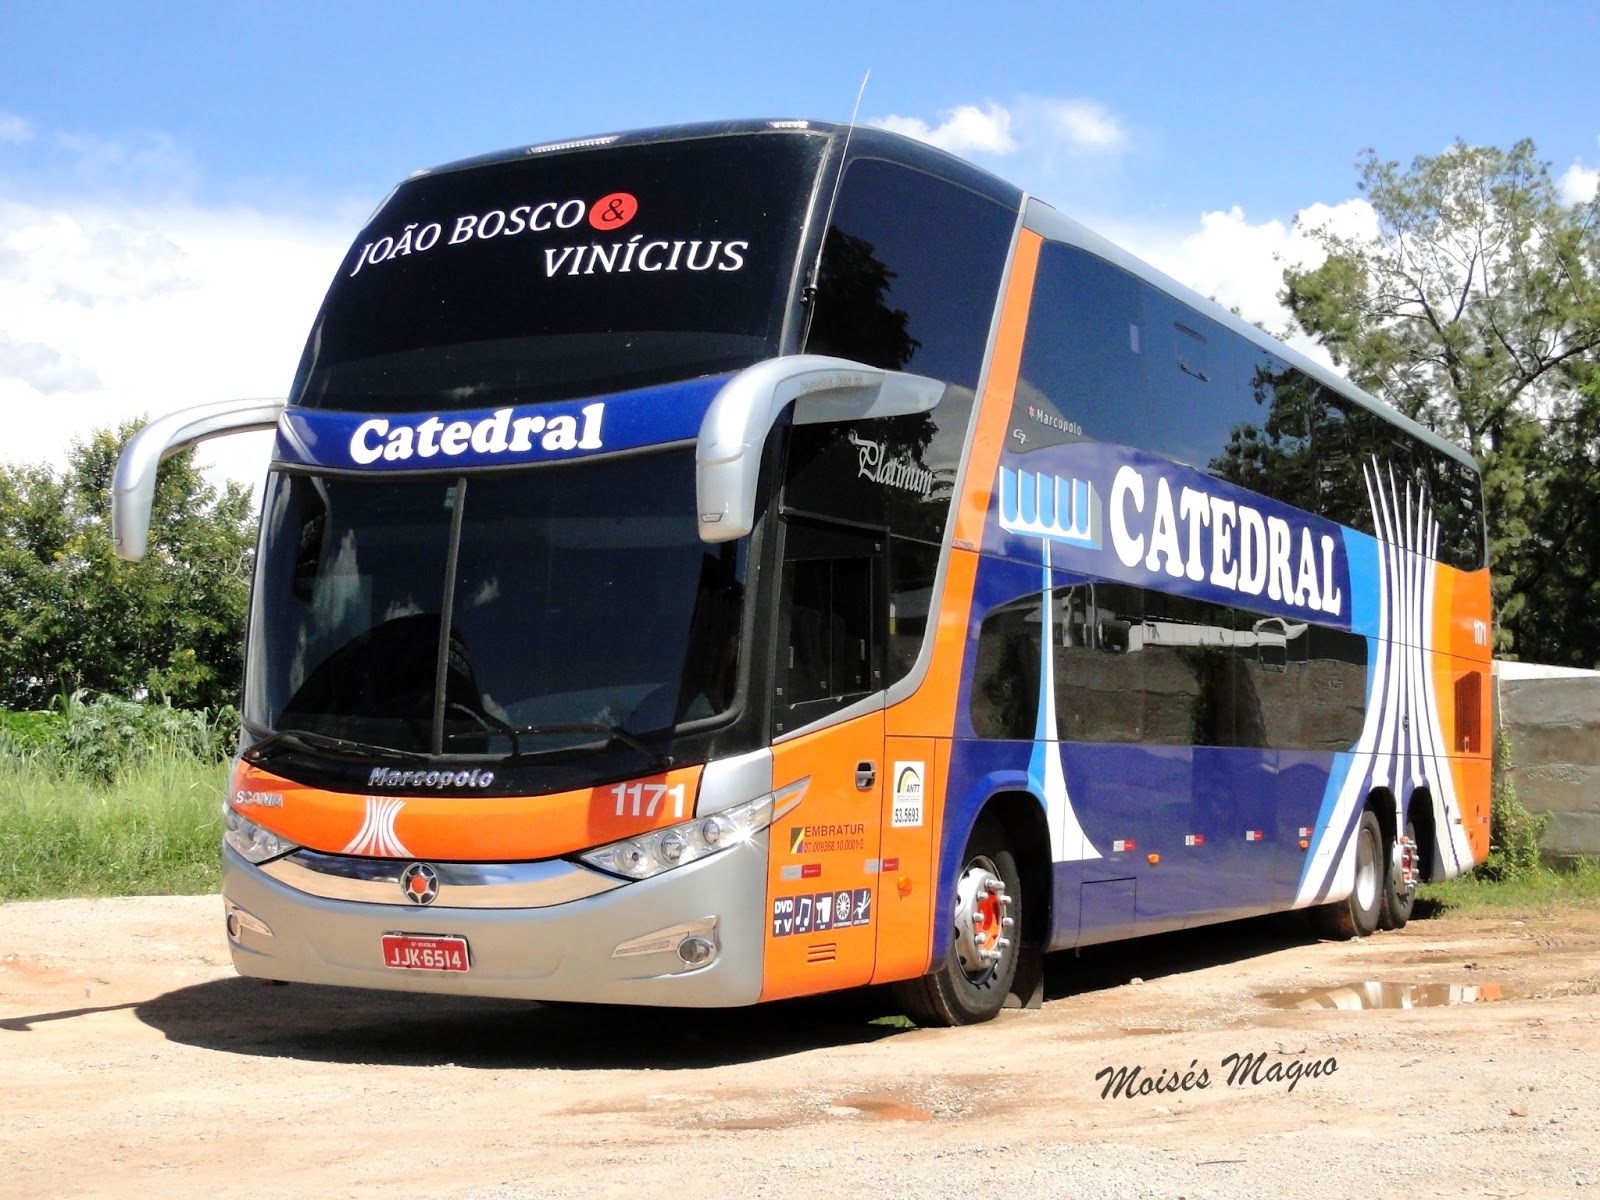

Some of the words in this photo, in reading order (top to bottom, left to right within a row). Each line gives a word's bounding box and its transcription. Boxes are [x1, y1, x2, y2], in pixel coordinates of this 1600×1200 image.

[350, 222, 441, 278] JOÃO
[448, 199, 586, 246] BOSCO
[601, 198, 625, 222] &
[543, 234, 749, 278] VINÍCIUS
[347, 402, 606, 465] Catedral
[1036, 408, 1082, 436] Marcopolo
[849, 432, 934, 495] Platinum
[1109, 465, 1342, 616] CATEDRAL
[367, 767, 495, 789] Marcopolo
[906, 784, 921, 793] ANTT
[235, 790, 284, 809] SCANIA
[610, 783, 686, 819] 1171
[895, 807, 919, 823] 53.5693
[804, 823, 865, 838] EMBRATUR
[774, 899, 793, 914] DVD
